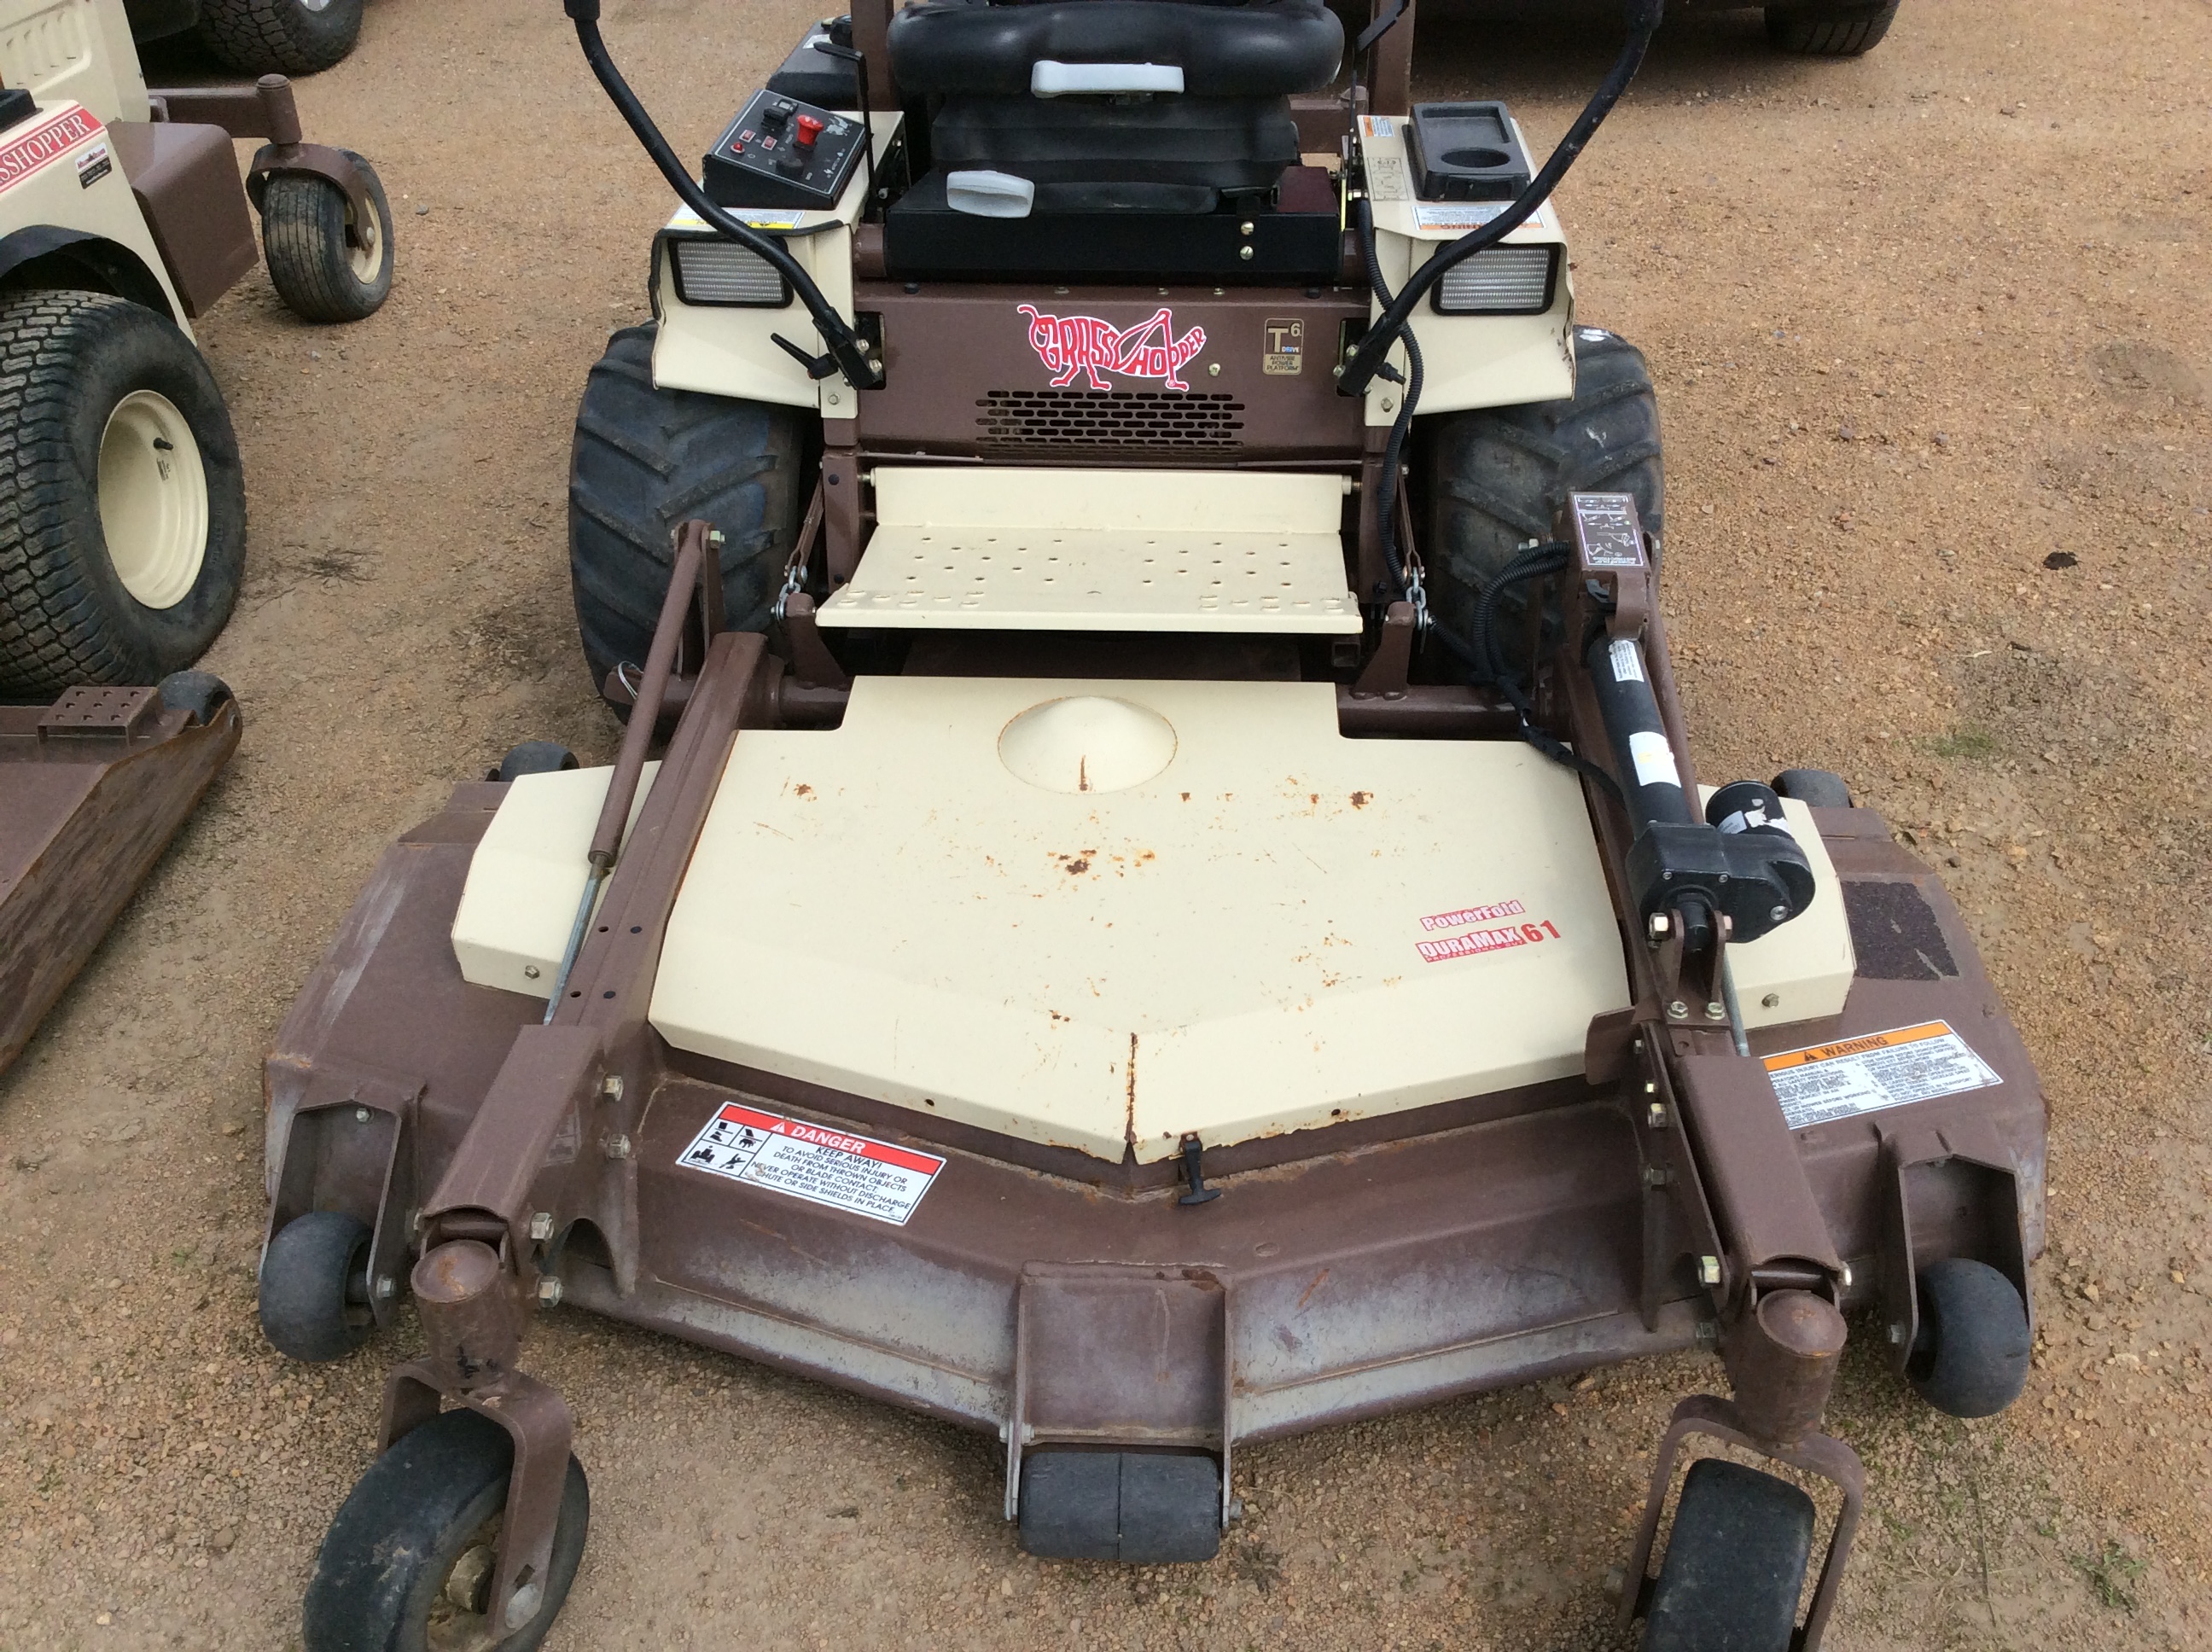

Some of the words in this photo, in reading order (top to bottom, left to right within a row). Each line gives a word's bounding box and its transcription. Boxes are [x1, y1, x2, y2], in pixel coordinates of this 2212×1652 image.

[1017, 305, 1207, 391] GRASSHOPPER
[1420, 900, 1524, 930] PowerFold
[1520, 920, 1561, 943] 61
[1820, 1036, 1889, 1057] WARNING
[791, 1125, 866, 1154] DANGER
[773, 1151, 801, 1163] DEATH
[801, 1159, 829, 1170] FROM
[830, 1166, 868, 1181] THROWN
[868, 1177, 907, 1192] OBJECTS
[782, 1145, 795, 1154] TO
[795, 1149, 824, 1161] AVOID
[824, 1157, 860, 1172] SERIOUS
[861, 1166, 893, 1180] INJURY
[893, 1176, 908, 1184] OR
[791, 1164, 805, 1172] OR
[806, 1167, 834, 1180] BLADE
[816, 1146, 844, 1159] KEEP
[844, 1155, 882, 1169] AWAY!
[780, 1169, 818, 1184] OPERATE
[819, 1179, 859, 1194] WITHOUT
[858, 1190, 911, 1210] DISCHARGE
[783, 1178, 799, 1186] OR
[798, 1182, 818, 1192] SIDE
[818, 1187, 853, 1201] SHIELDS
